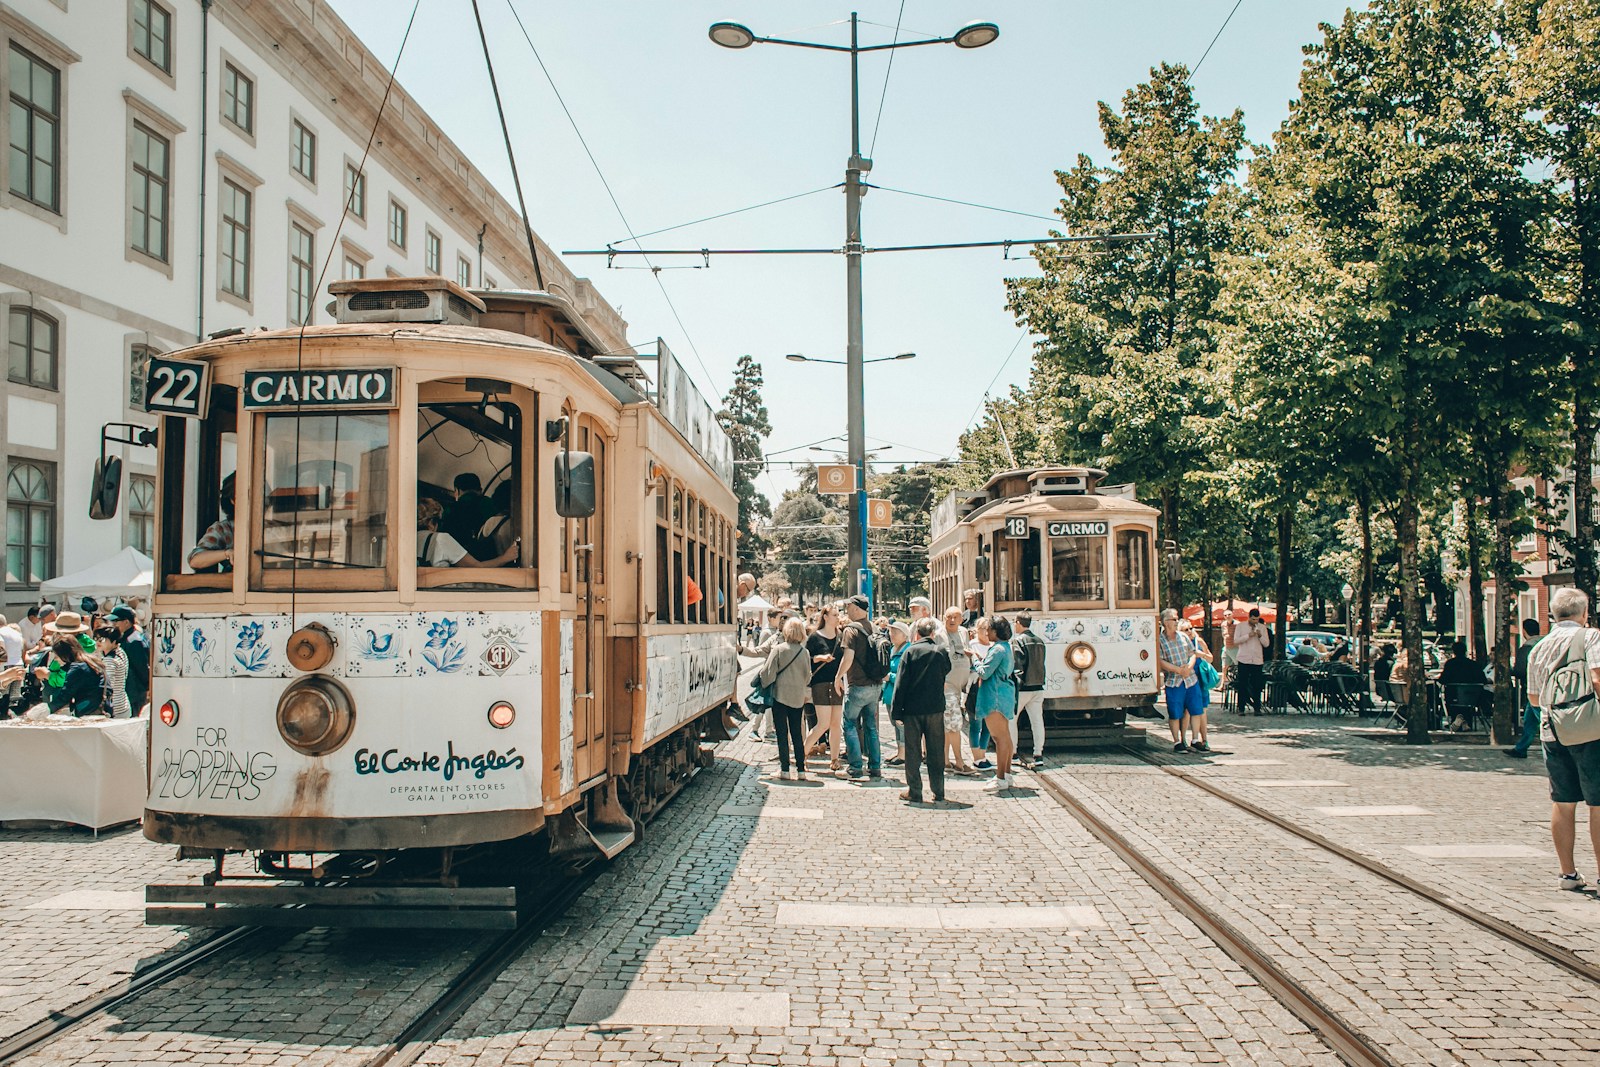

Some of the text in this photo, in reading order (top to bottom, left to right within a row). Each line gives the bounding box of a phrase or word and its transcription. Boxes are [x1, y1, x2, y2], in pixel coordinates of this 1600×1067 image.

[150, 366, 198, 408] 22
[251, 373, 386, 402] CARMO
[1007, 519, 1026, 536] 18
[1050, 522, 1106, 536] CARMO
[1096, 670, 1106, 680] El
[1106, 670, 1128, 680] Corte
[196, 727, 227, 747] FOR
[158, 747, 277, 781] SHOPPING
[354, 740, 525, 781] El Corte Inglés
[159, 769, 260, 801] LOVERS
[390, 783, 506, 794] DEPARTMENT STORES
[407, 794, 435, 802] GAIA
[452, 792, 489, 801] PORTO
